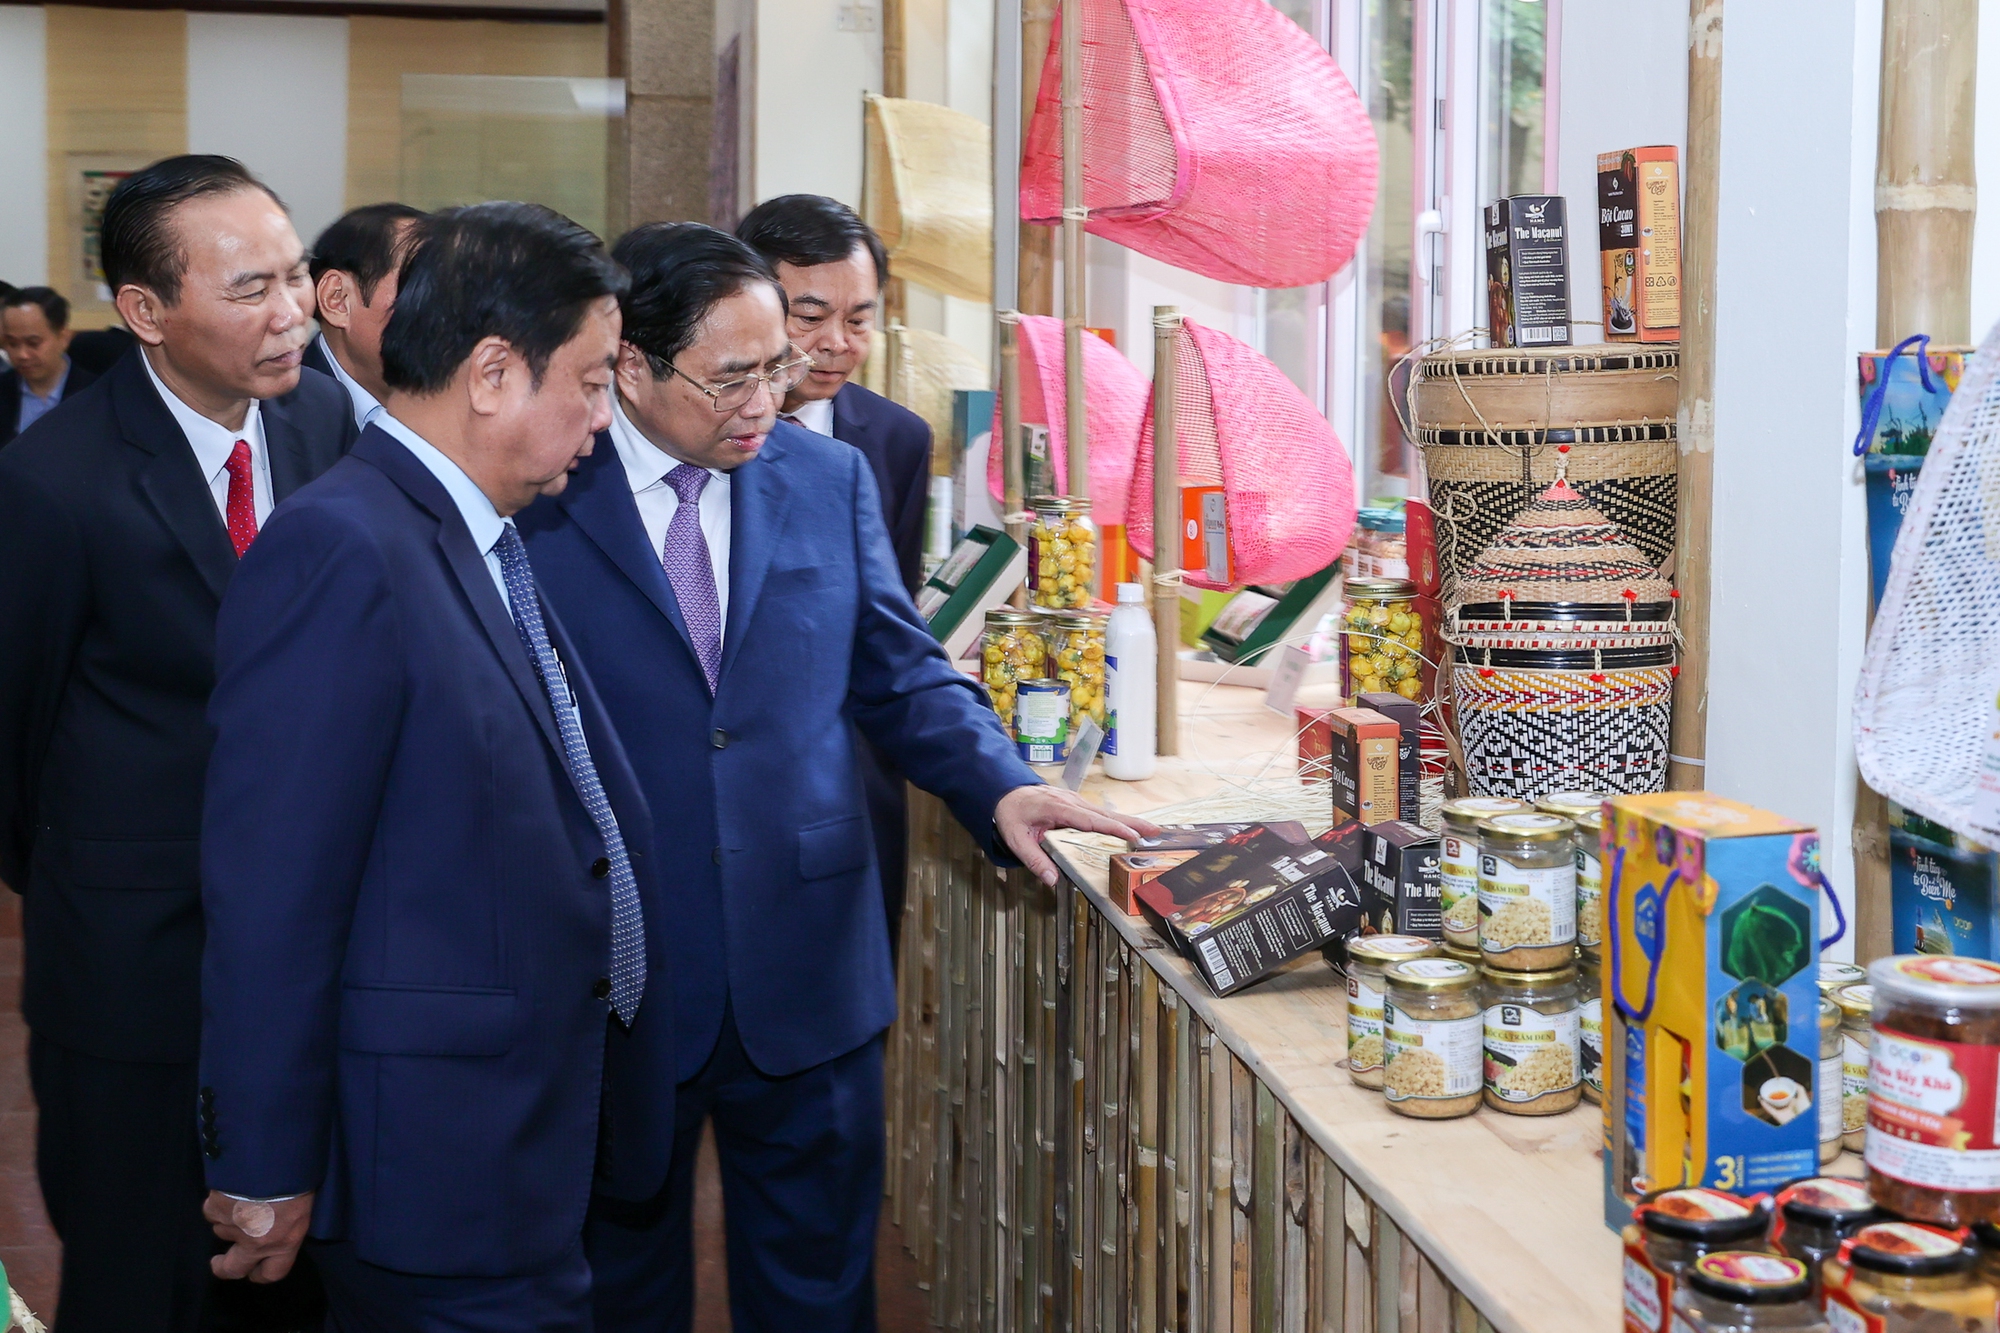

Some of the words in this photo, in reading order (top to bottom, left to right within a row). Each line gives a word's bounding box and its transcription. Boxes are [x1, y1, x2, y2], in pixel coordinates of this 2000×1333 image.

[1613, 206, 1634, 223] Cacao
[1514, 226, 1530, 240] The
[1531, 225, 1563, 240] Macanut
[1341, 770, 1356, 791] Cacao
[1303, 883, 1318, 904] The
[1404, 883, 1422, 898] The
[1310, 900, 1336, 938] Macanut
[1714, 1155, 1736, 1190] 3
